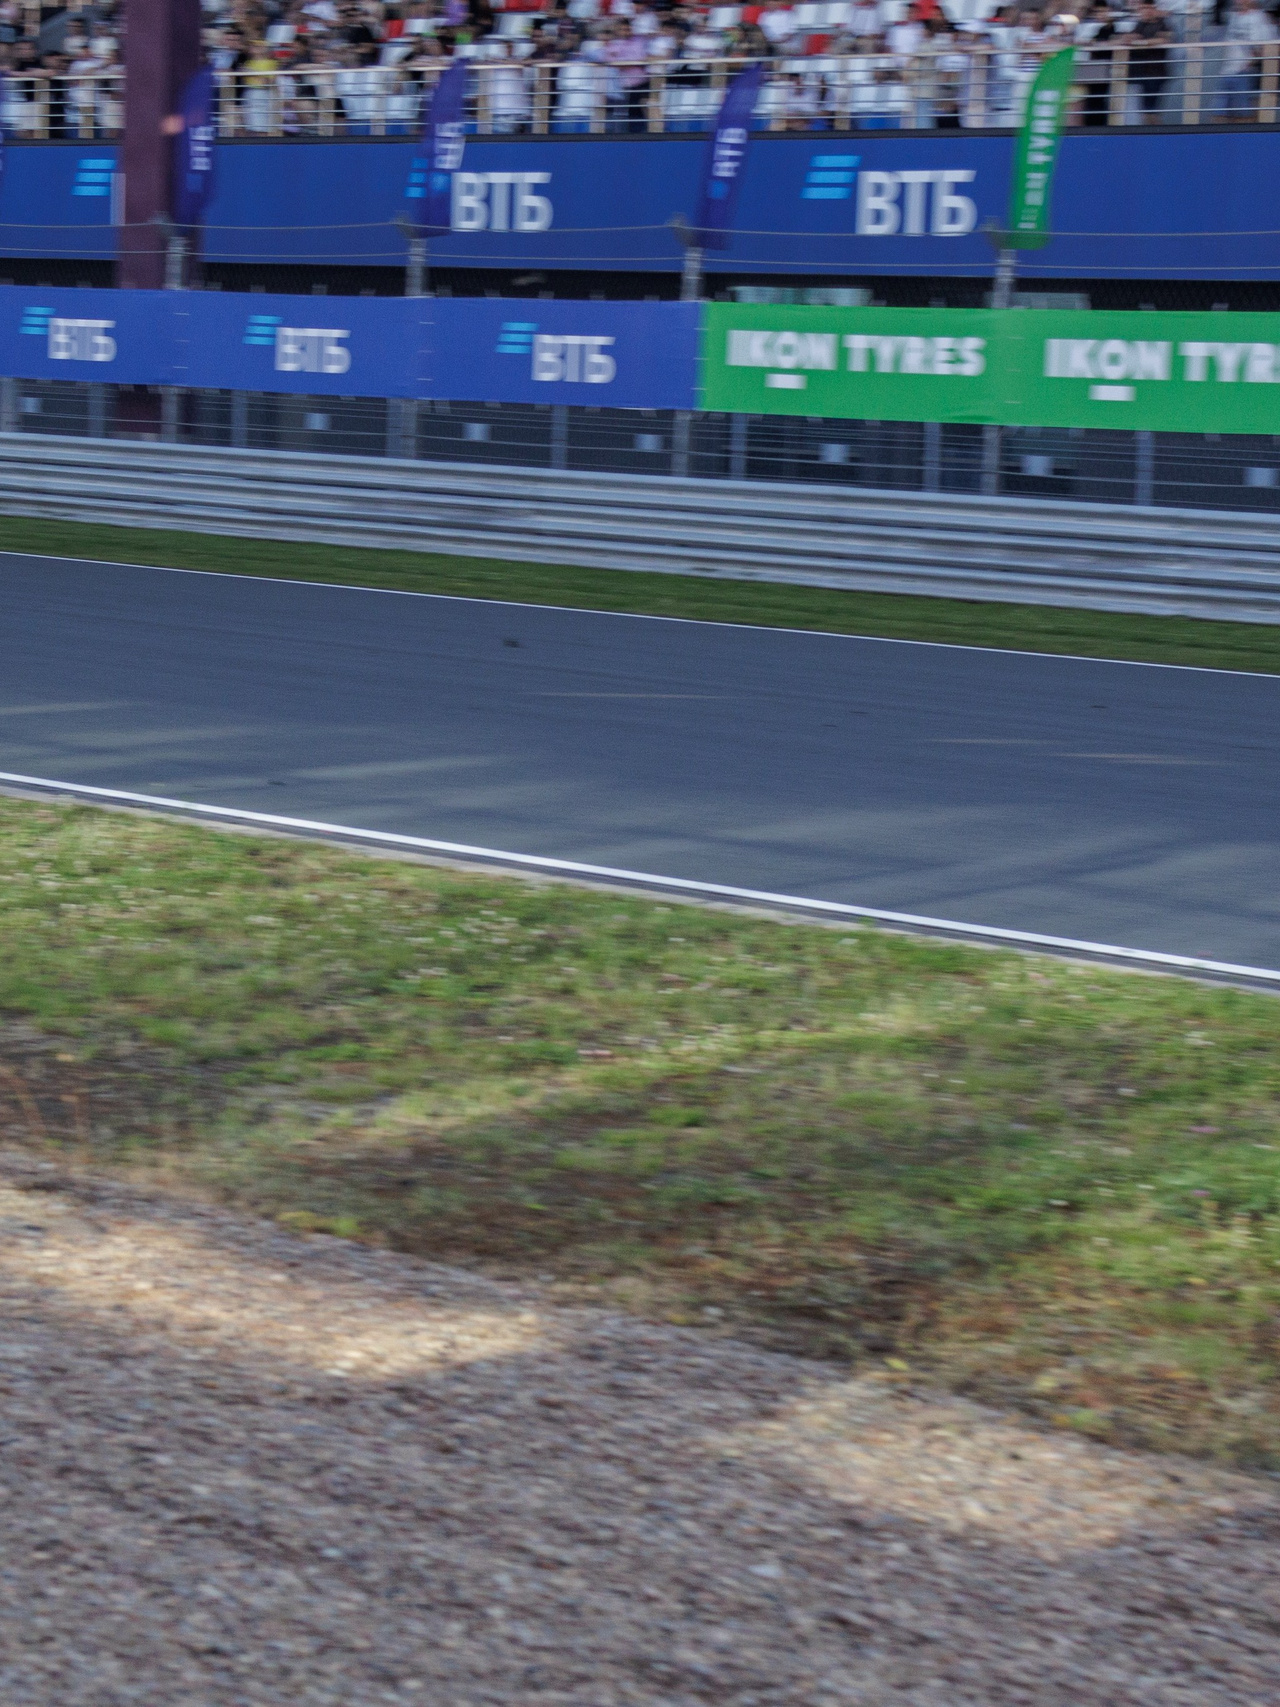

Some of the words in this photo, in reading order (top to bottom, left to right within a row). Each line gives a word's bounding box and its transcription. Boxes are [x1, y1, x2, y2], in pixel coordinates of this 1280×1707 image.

[451, 172, 554, 232] ВТБ
[855, 169, 978, 236] ВТБ
[48, 318, 117, 362] ВТБ
[275, 327, 351, 374] ВТБ
[531, 335, 616, 383] ВТБ
[727, 330, 838, 370] IKON
[843, 334, 987, 377] TYRES
[1044, 338, 1172, 381] IKON
